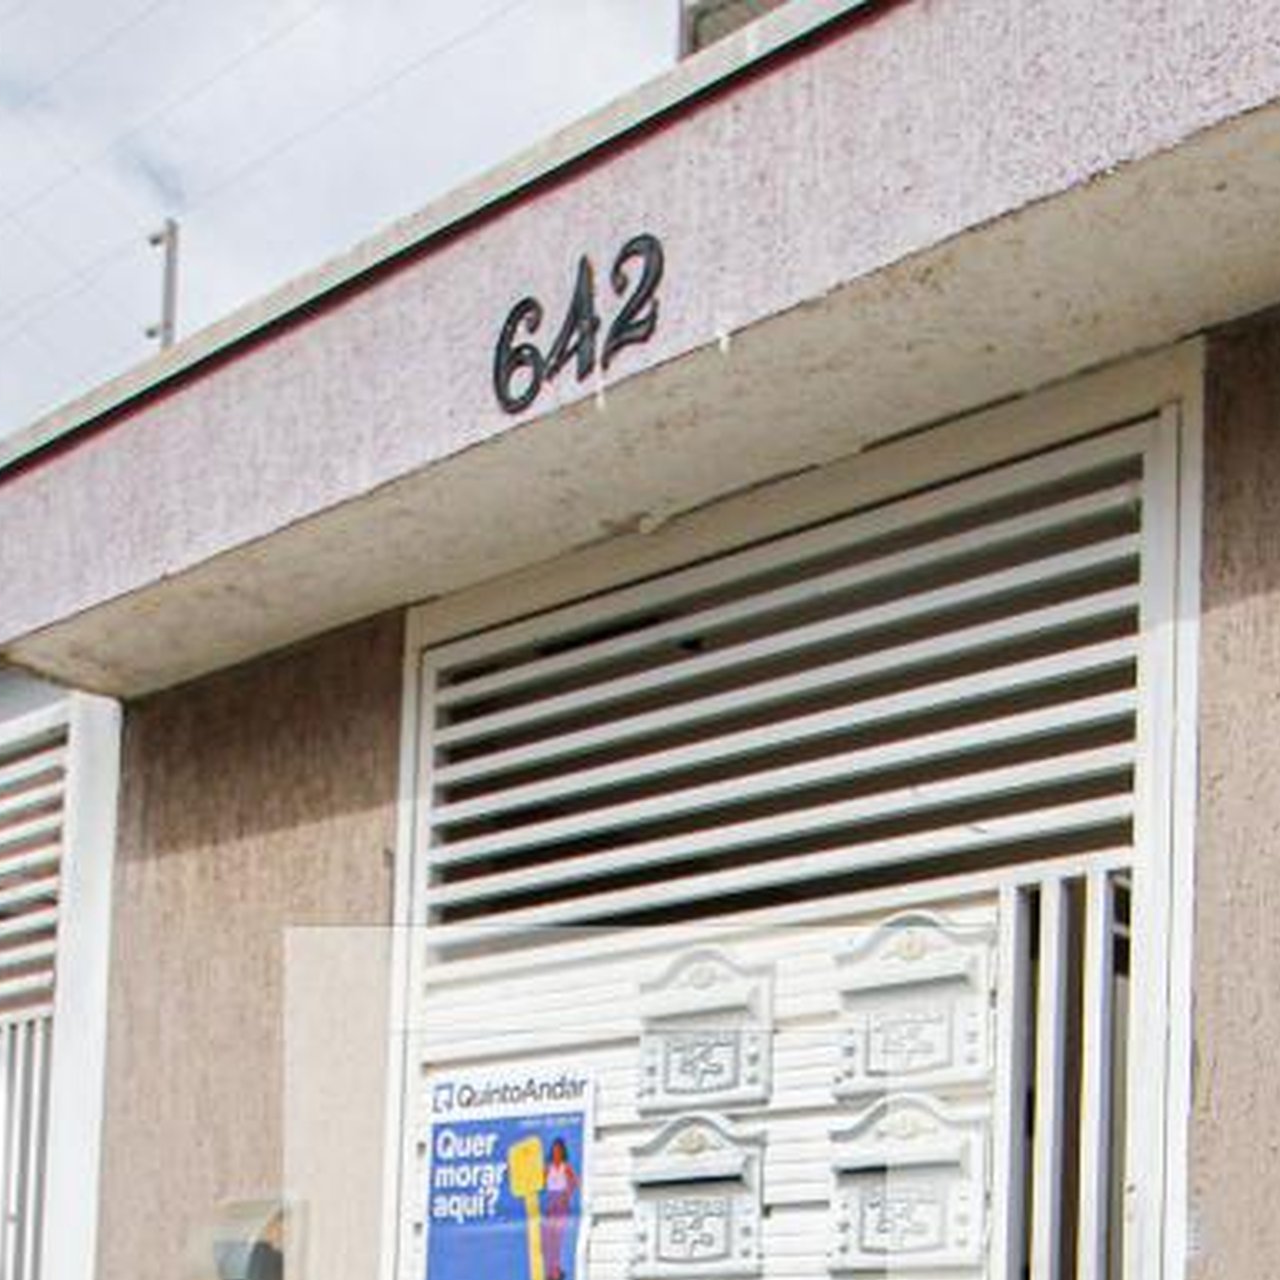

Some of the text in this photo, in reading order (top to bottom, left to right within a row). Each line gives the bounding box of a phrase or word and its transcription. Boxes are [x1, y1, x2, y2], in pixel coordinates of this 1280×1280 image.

[494, 234, 664, 414] 642
[456, 1076, 588, 1108] QuintoAndar
[435, 1128, 499, 1160] Quer
[434, 1161, 508, 1188] morar
[432, 1187, 500, 1224] aqui?
